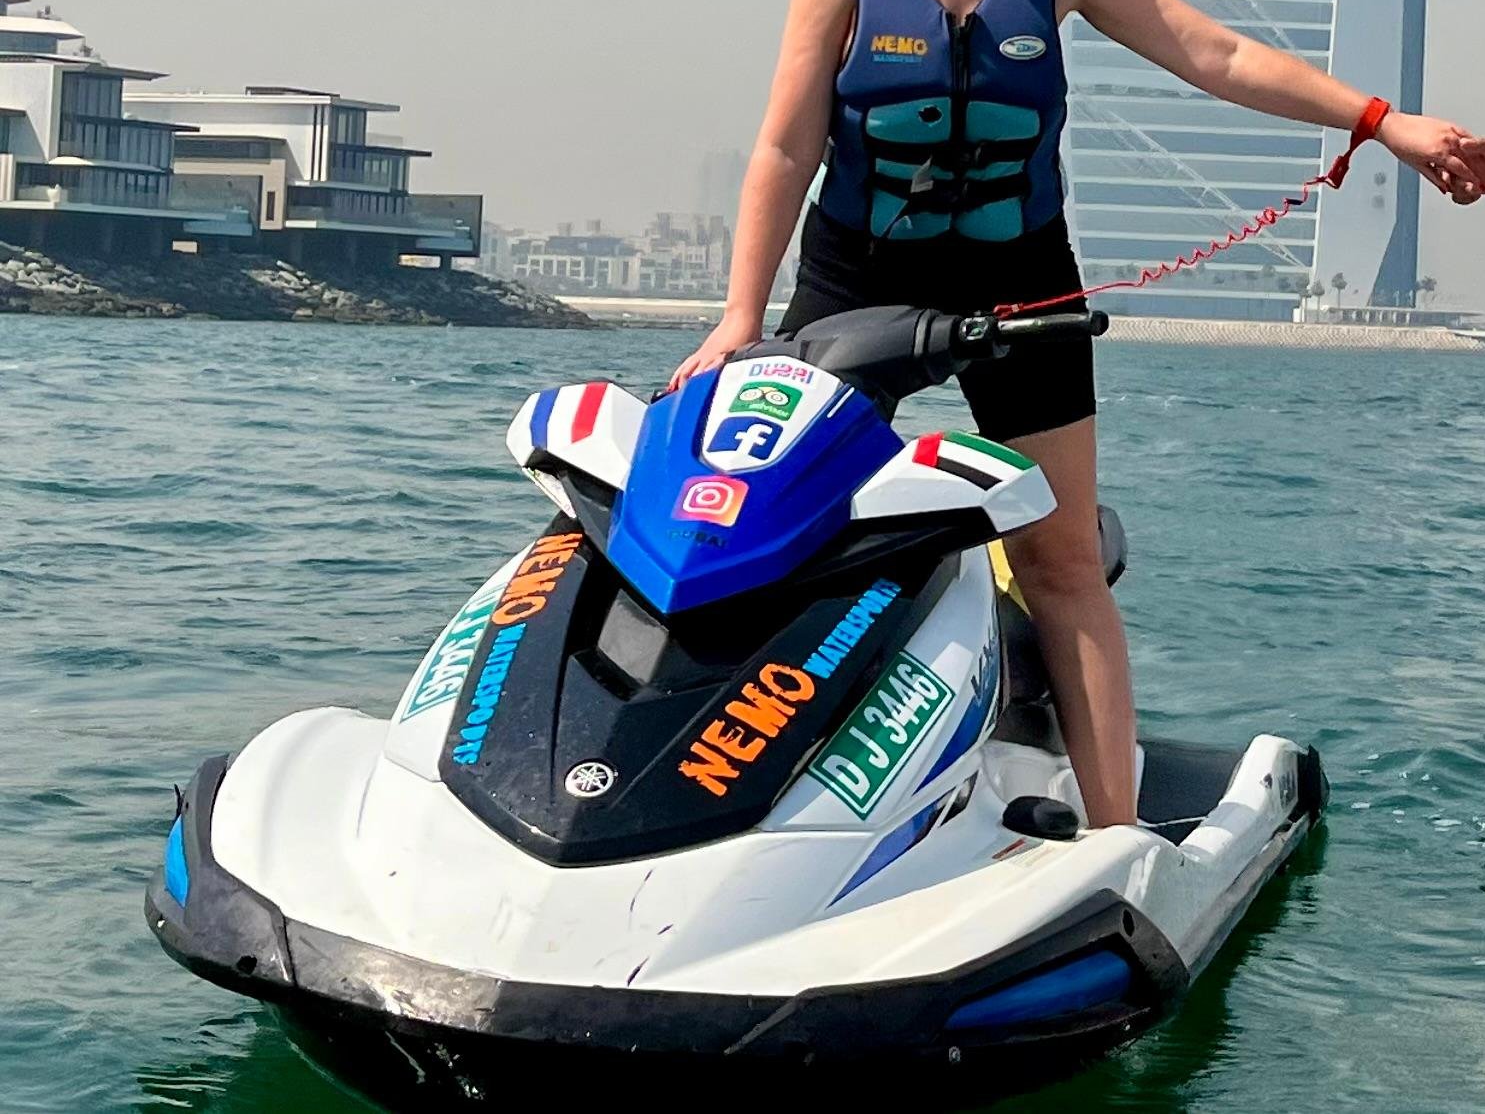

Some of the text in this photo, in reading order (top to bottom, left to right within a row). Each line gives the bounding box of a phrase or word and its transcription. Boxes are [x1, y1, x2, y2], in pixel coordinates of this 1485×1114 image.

[870, 35, 928, 56] NEMO
[492, 533, 583, 625] NEMO
[678, 663, 815, 797] NEMO
